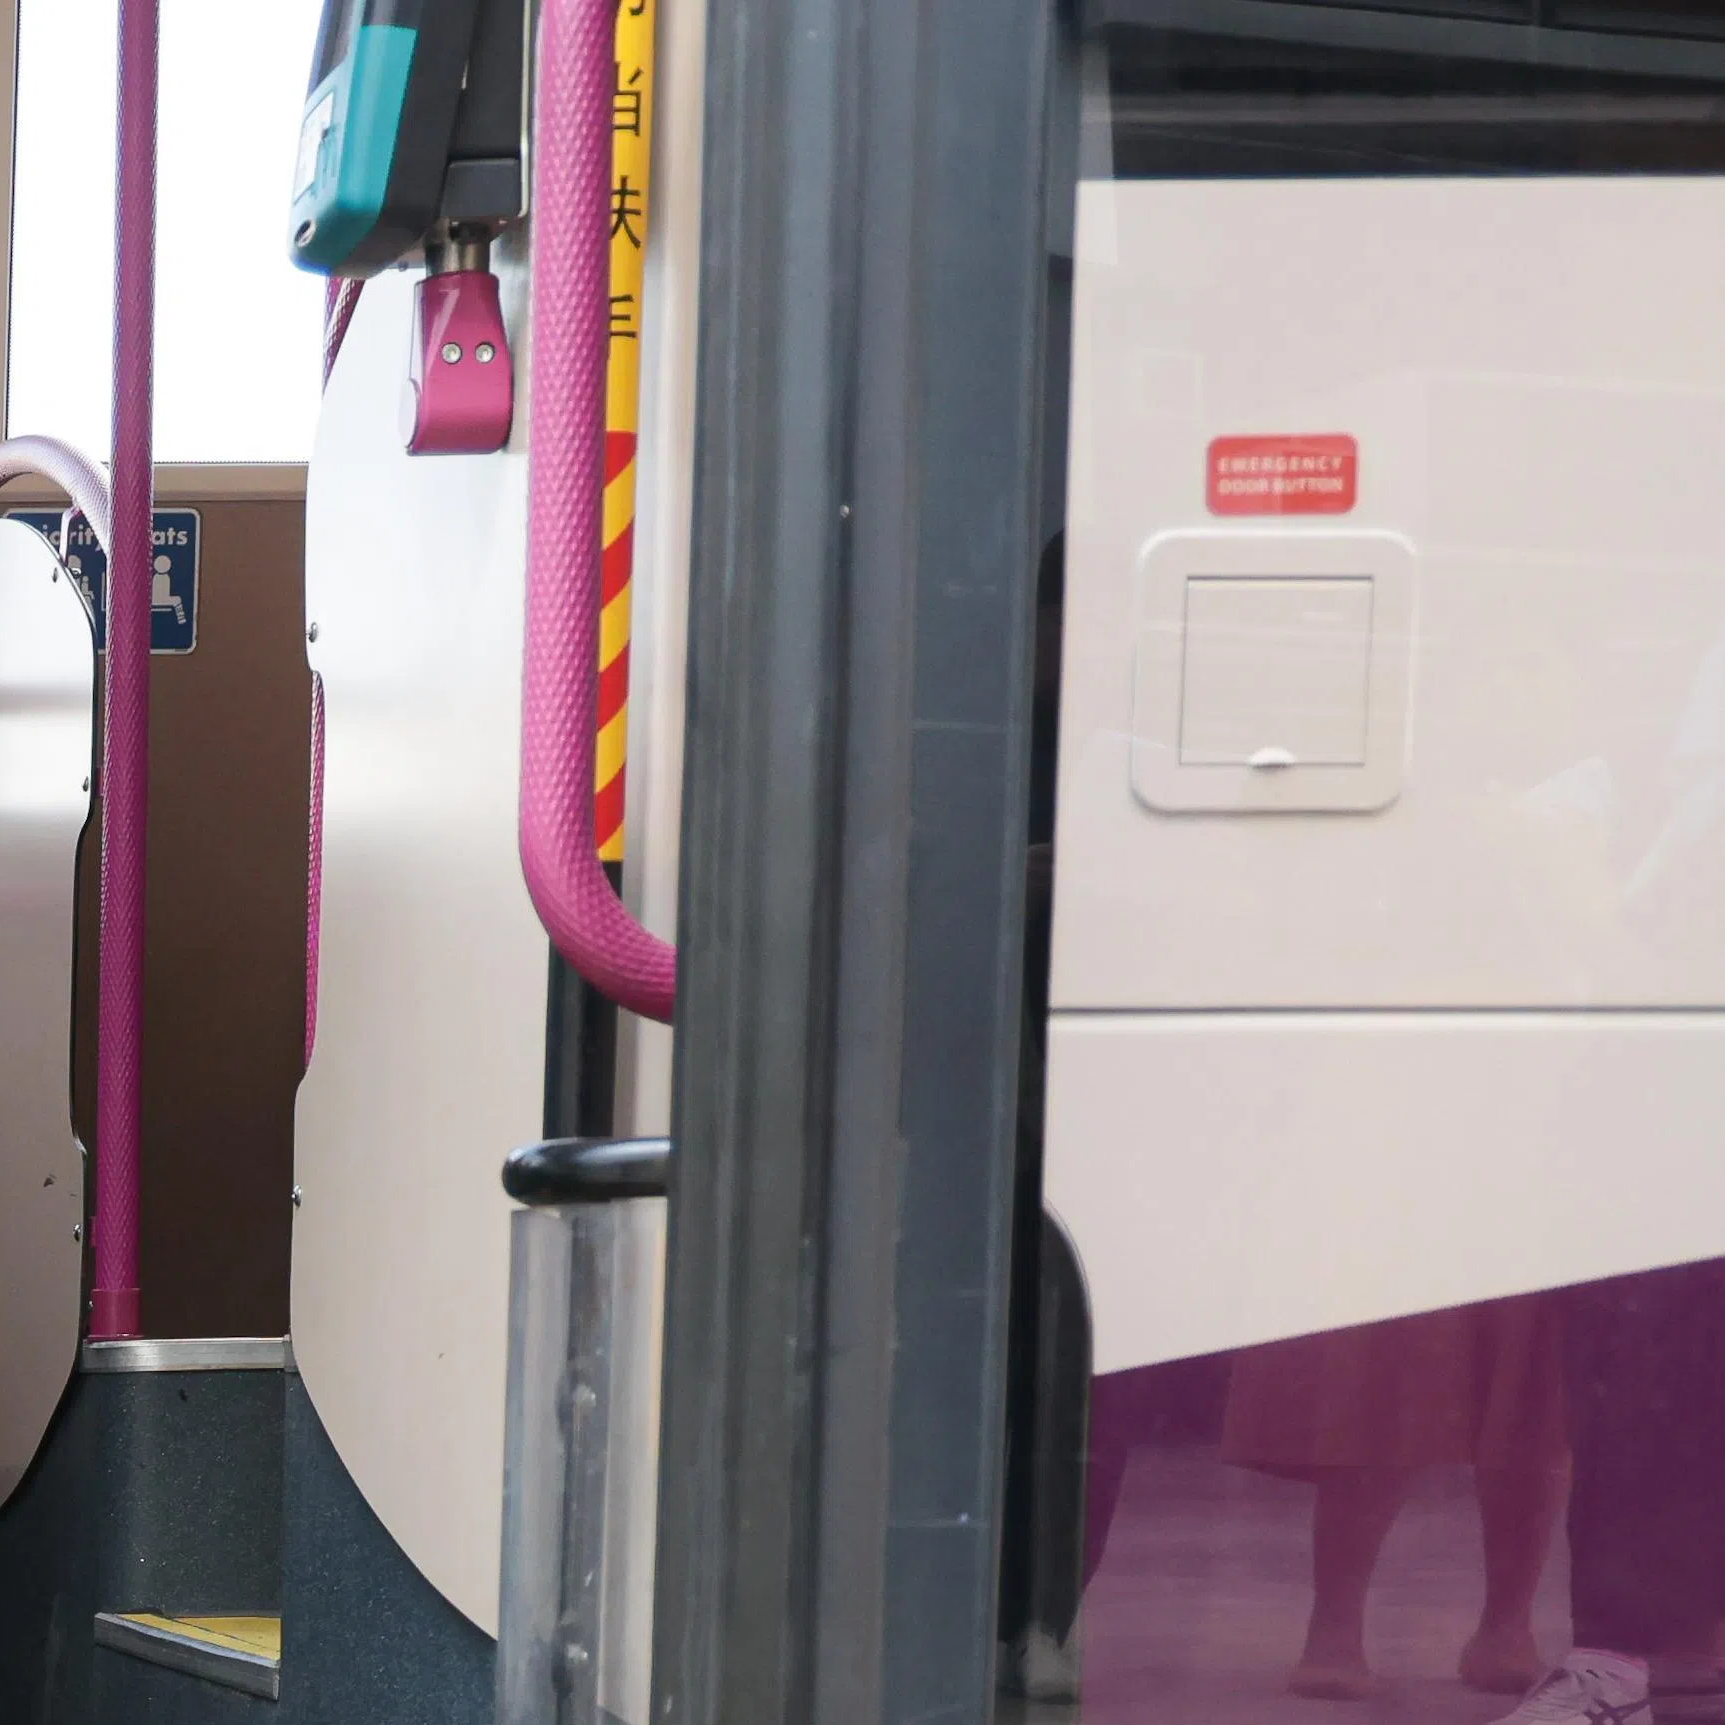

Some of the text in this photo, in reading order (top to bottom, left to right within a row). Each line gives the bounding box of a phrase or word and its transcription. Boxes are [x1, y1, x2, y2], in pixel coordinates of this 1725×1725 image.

[1218, 456, 1343, 473] EMERGENCY
[1218, 477, 1344, 495] DOOR BUTTON
[149, 527, 189, 545] ats
